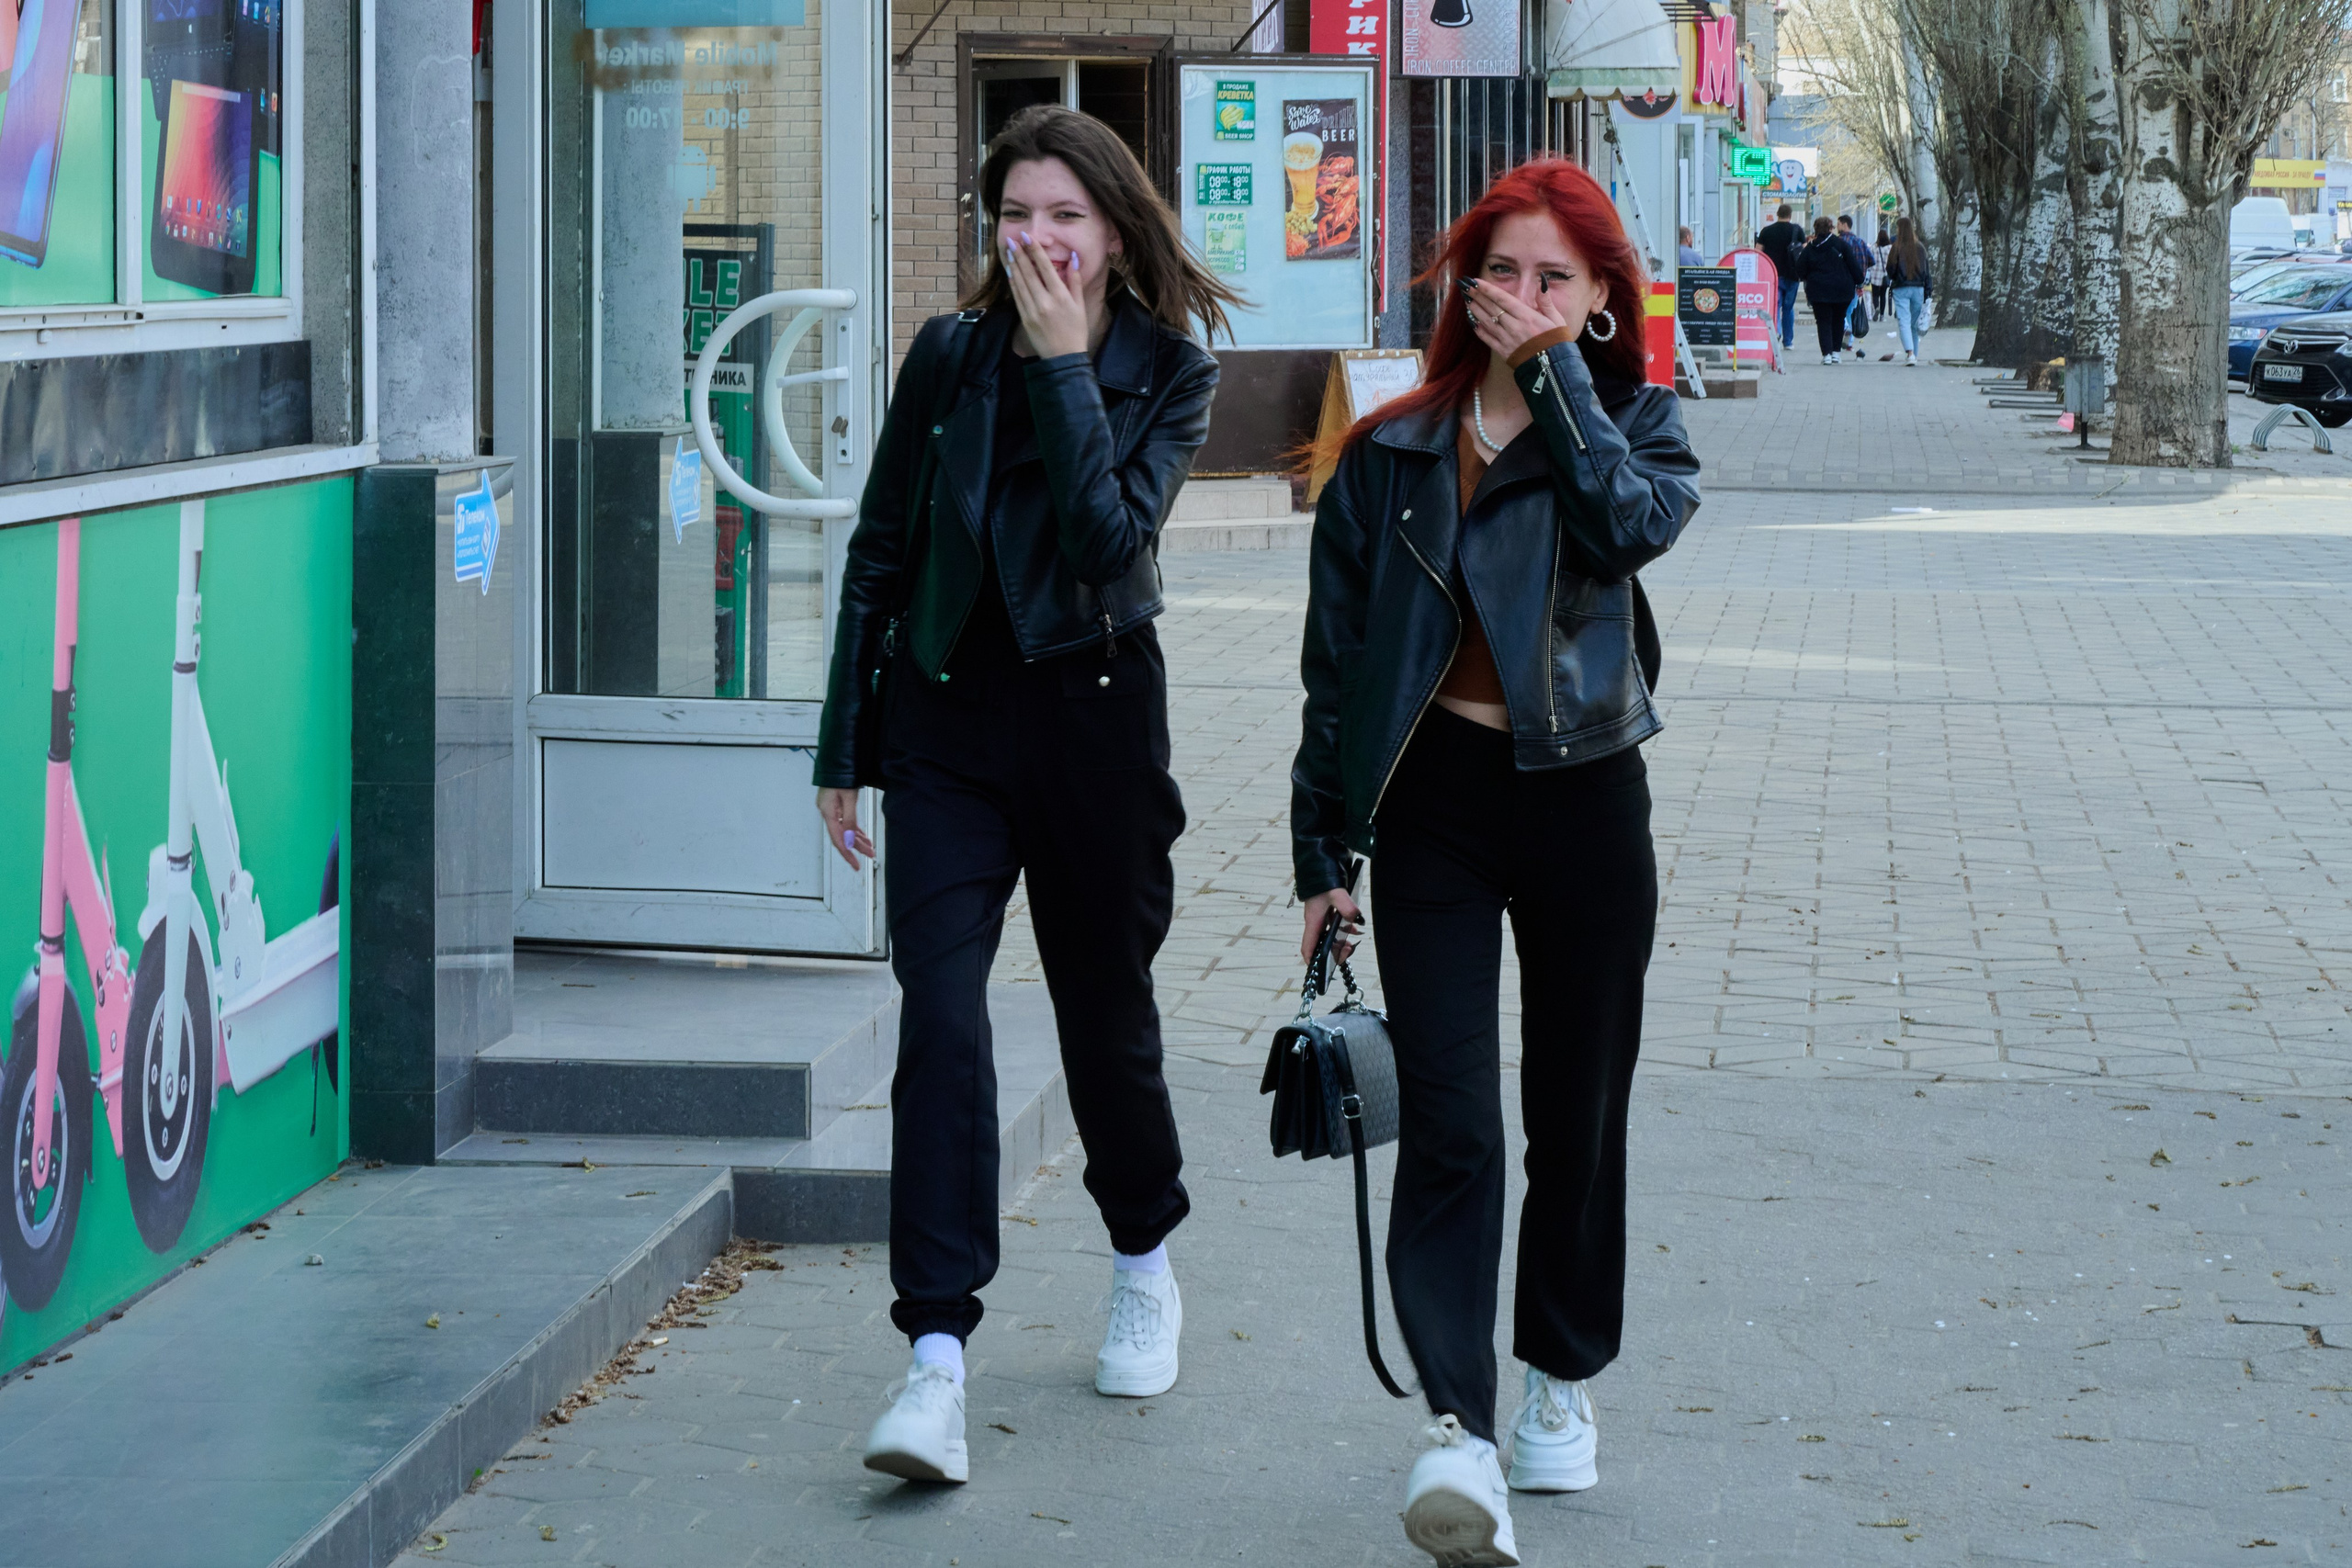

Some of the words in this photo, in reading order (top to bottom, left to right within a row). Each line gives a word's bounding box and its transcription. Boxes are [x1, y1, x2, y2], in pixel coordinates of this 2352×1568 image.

[1405, 28, 1419, 56] IRON
[1407, 60, 1431, 74] IRON
[1435, 60, 1471, 74] COFFEE
[1476, 60, 1517, 74] CENTER
[1217, 90, 1254, 100] КРЕВЕТКА
[1288, 104, 1312, 117] Save
[1322, 105, 1356, 129] DRINK
[1288, 108, 1321, 131] Water
[1322, 129, 1355, 142] BEER
[1206, 165, 1227, 174] ГРАФИК
[1229, 165, 1250, 174] РАБОТЫ
[1207, 212, 1244, 221] КОФЕ
[465, 509, 485, 525] Телеком
